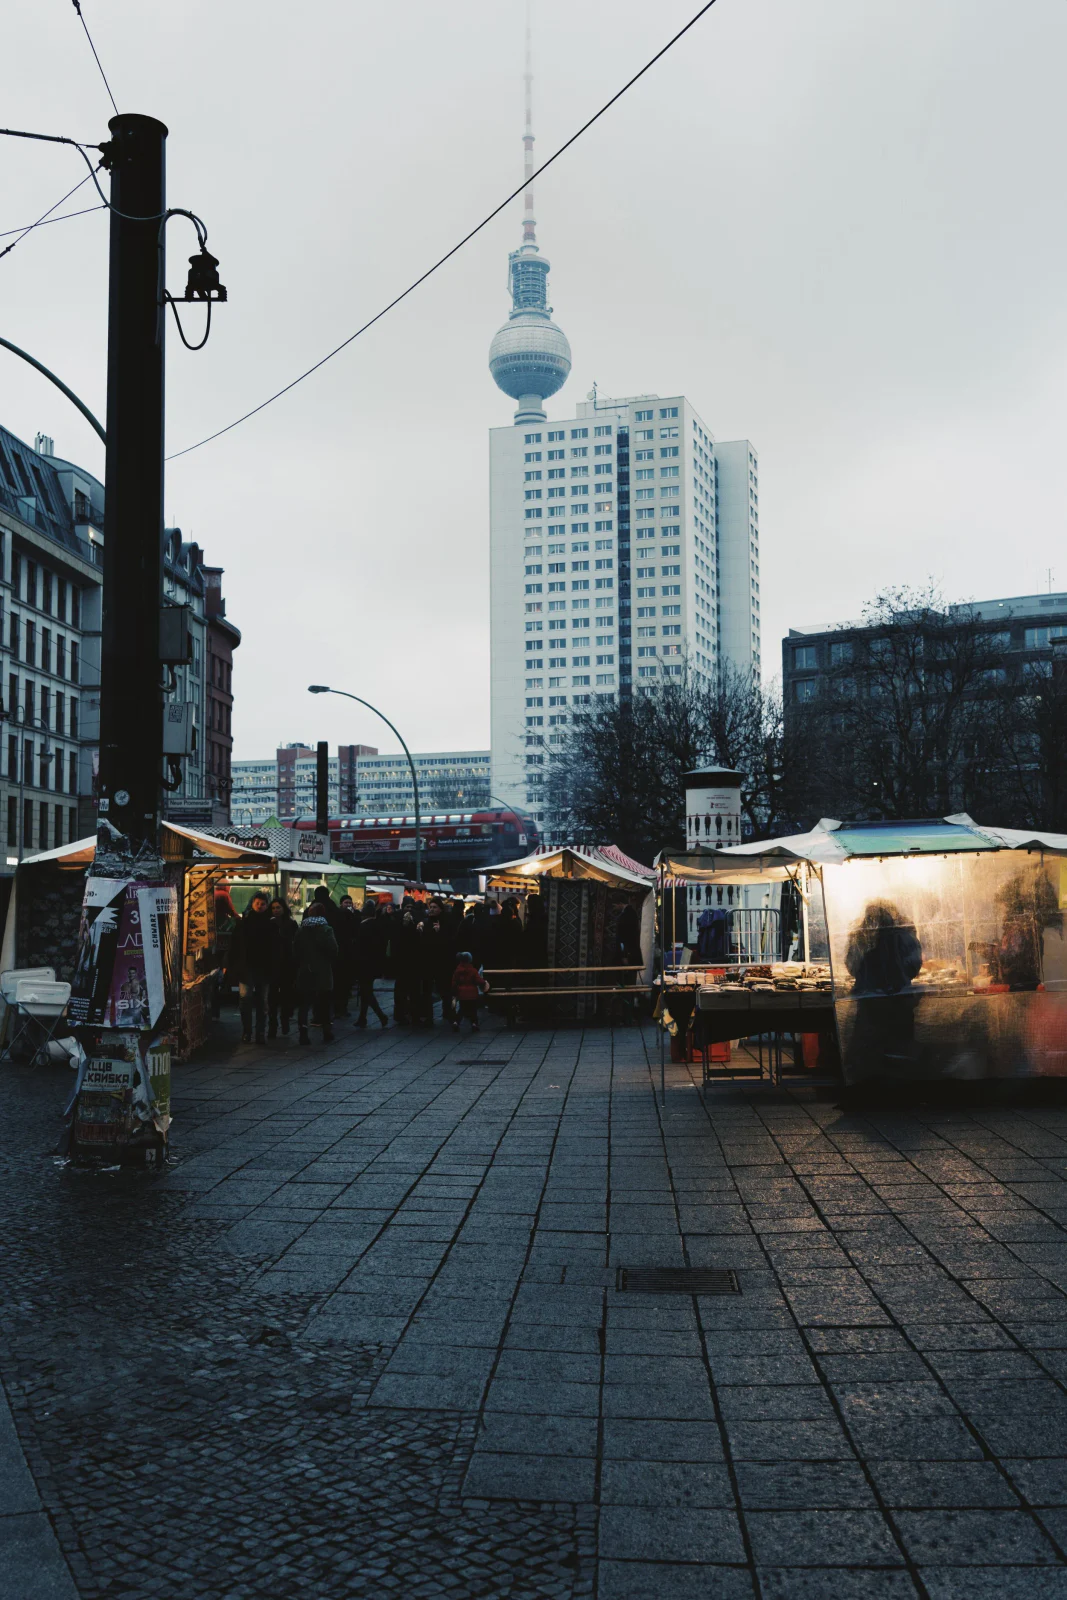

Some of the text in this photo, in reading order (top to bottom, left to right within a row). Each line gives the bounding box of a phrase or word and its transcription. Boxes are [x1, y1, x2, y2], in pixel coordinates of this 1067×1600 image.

[130, 910, 139, 924] 3
[150, 914, 159, 948] SCHWARZ
[118, 998, 147, 1009] SIX
